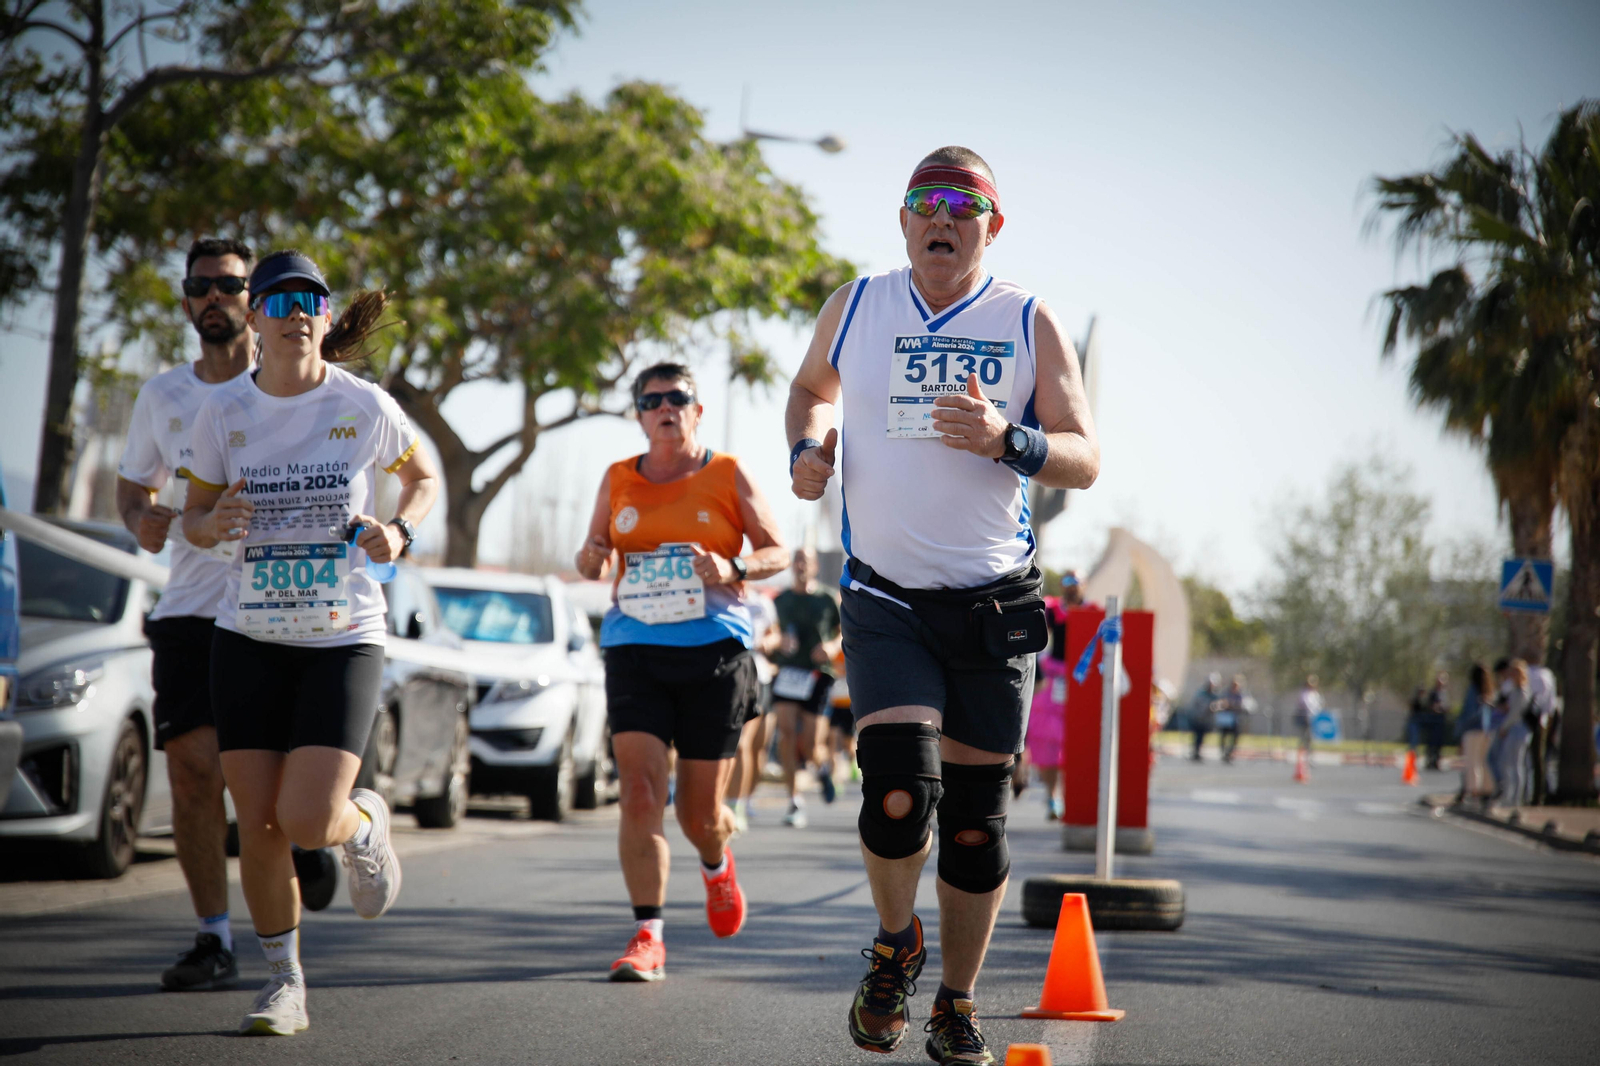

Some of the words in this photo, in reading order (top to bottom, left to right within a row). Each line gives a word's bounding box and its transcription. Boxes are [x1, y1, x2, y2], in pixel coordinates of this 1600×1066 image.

[932, 341, 957, 349] Almería
[957, 343, 975, 351] 2024
[904, 353, 1003, 386] 5130
[239, 465, 281, 477] Medio
[287, 461, 349, 475] Maratón
[241, 477, 300, 495] Almería
[304, 473, 349, 490] 2024
[278, 496, 302, 505] RUIZ
[304, 492, 350, 503] ANDÚJAR
[251, 559, 339, 591] 5804
[627, 556, 693, 585] 5546
[278, 590, 295, 598] DEL
[297, 589, 318, 597] MAR
